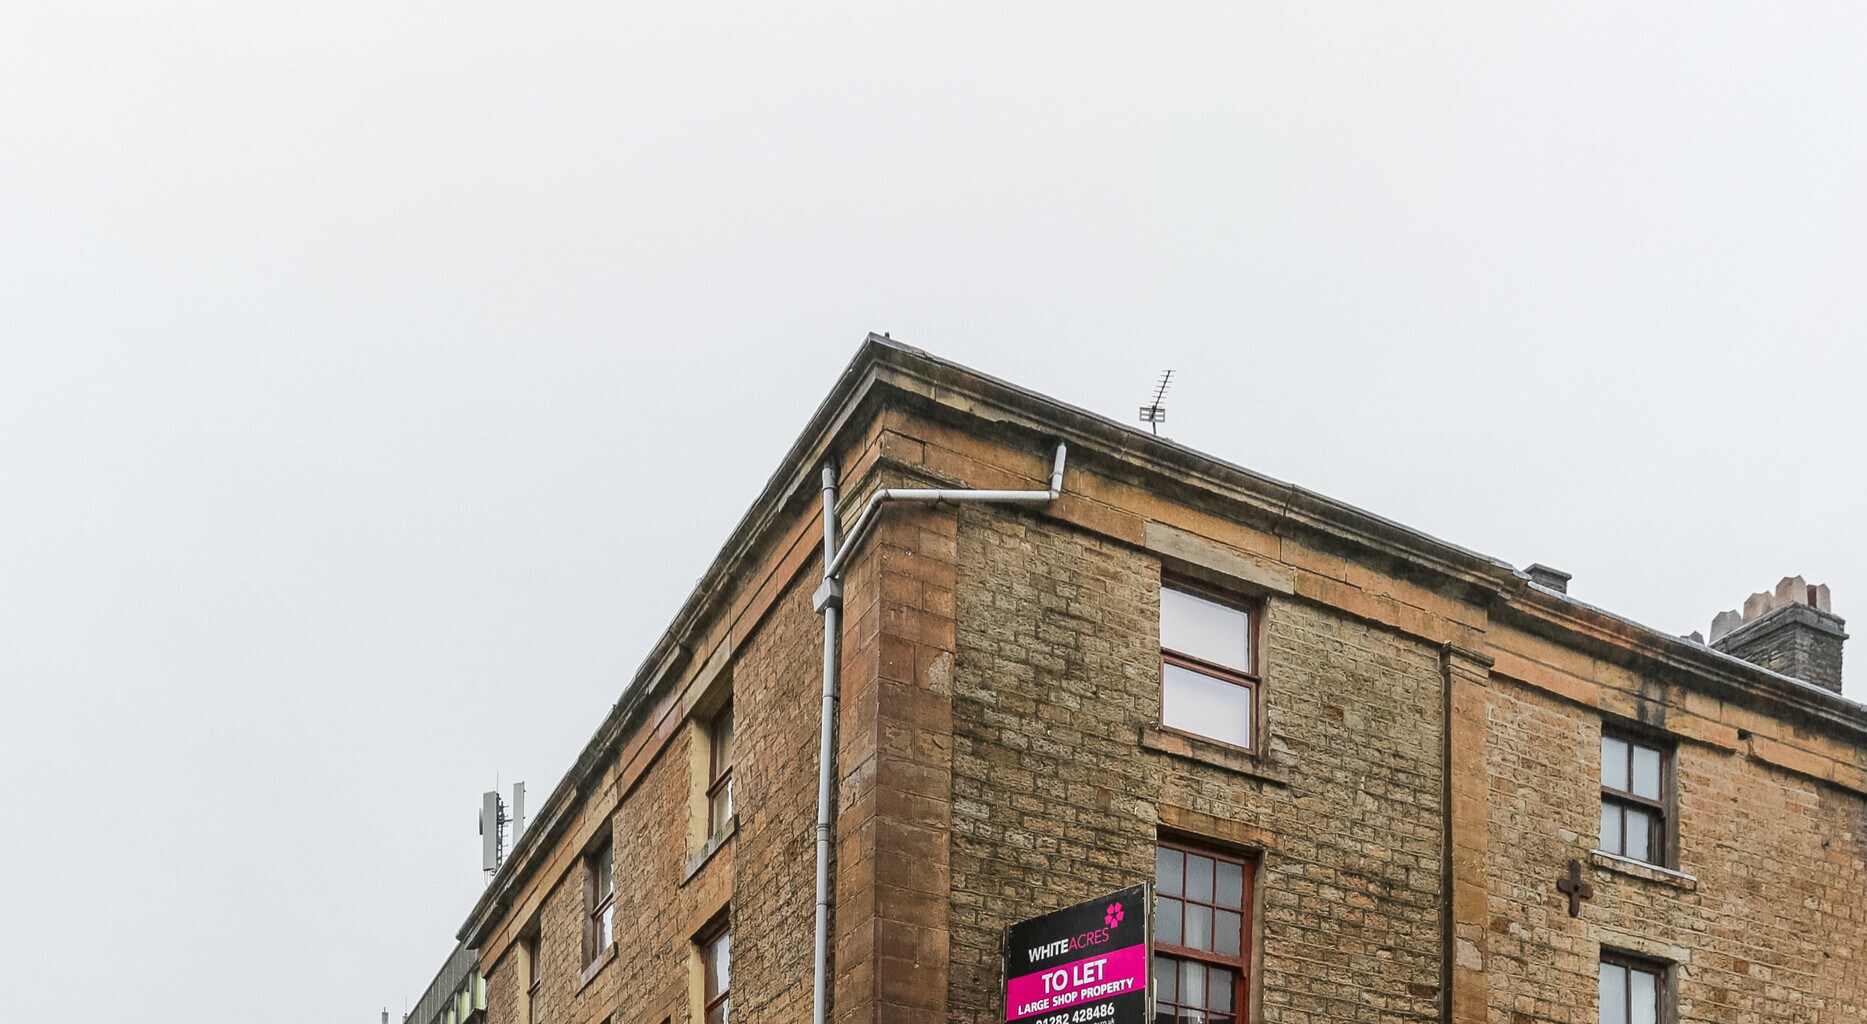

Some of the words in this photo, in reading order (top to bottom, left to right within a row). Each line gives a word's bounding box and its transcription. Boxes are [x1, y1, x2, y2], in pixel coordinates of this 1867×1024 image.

[1028, 927, 1110, 963] WHITEACRES
[1041, 969, 1068, 994] TO
[1073, 959, 1107, 987] LET
[1018, 1000, 1050, 1016] LARGE
[1052, 991, 1078, 1007] SHOP
[1081, 977, 1135, 1000] PROPERTY
[1072, 1002, 1115, 1024] 428486
